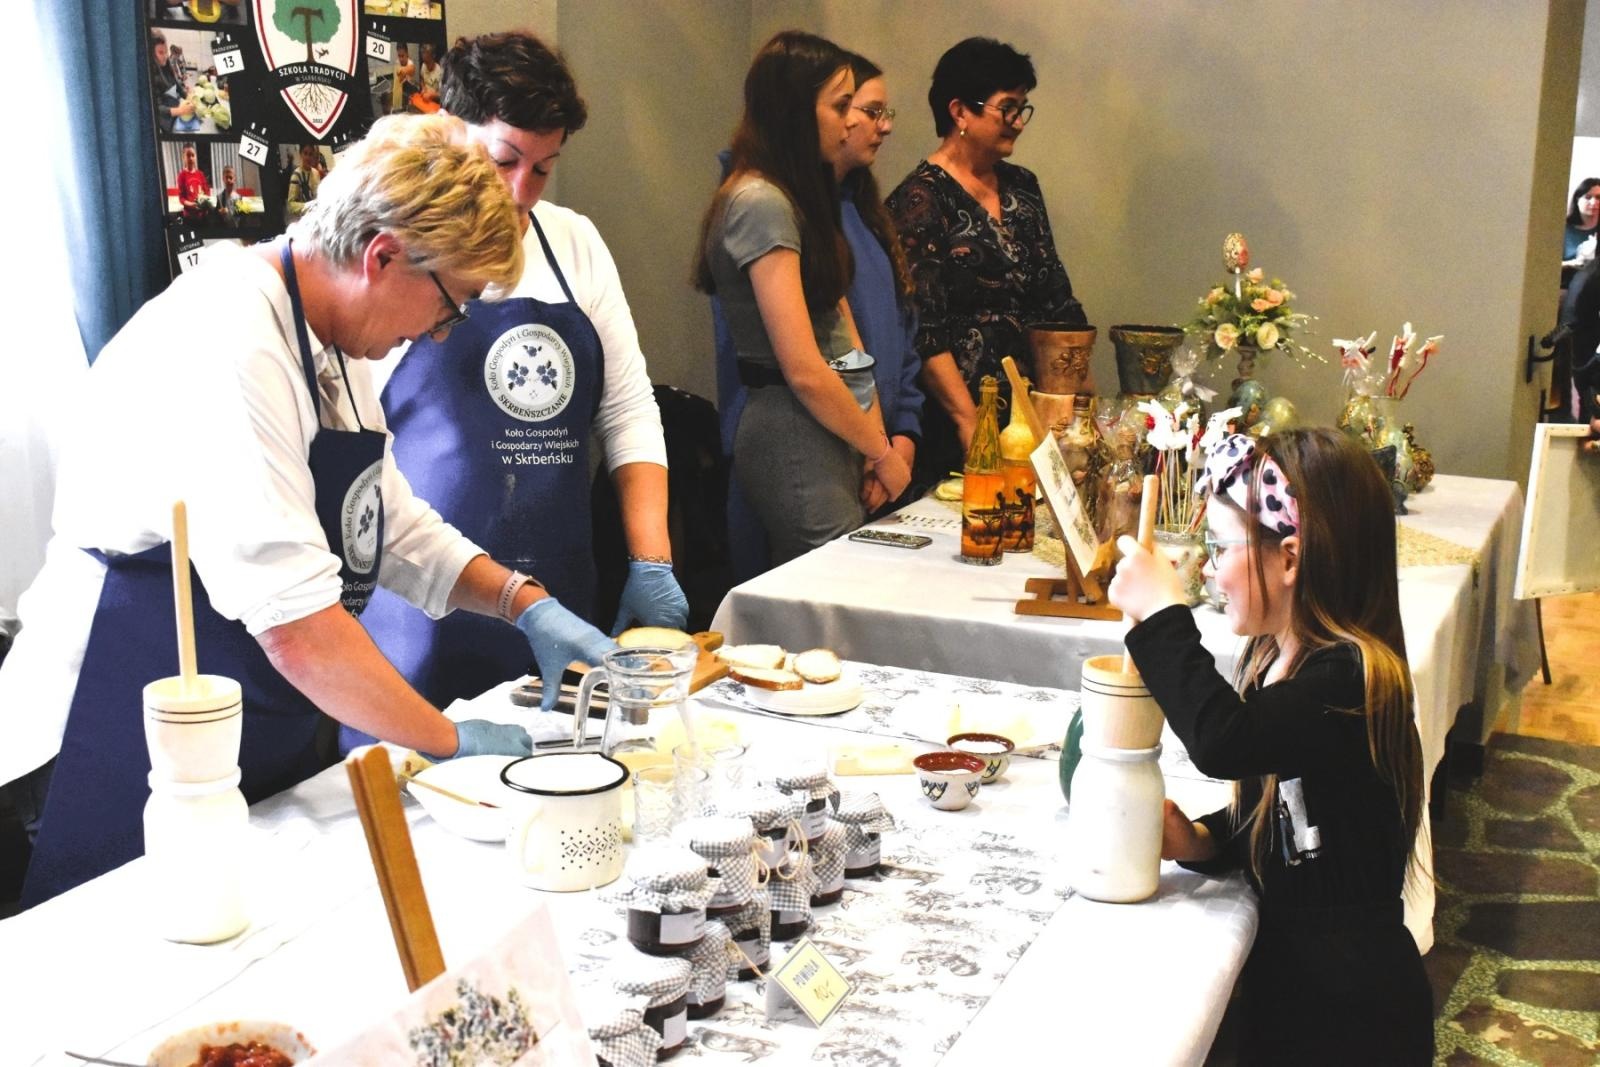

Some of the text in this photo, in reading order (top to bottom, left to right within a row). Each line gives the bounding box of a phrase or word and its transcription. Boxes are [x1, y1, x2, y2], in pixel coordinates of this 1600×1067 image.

[372, 42, 385, 55] 20
[223, 56, 235, 69] 13
[310, 66, 346, 80] TRADYCJI
[246, 142, 261, 157] 27
[187, 253, 198, 267] 17
[498, 393, 567, 418] SKRBEŃSZCZANIE
[505, 427, 568, 438] Koło Gospodyń
[495, 440, 542, 451] Gospodarzy
[544, 439, 580, 450] Wiejskich
[502, 451, 574, 465] w Skrbeńsku
